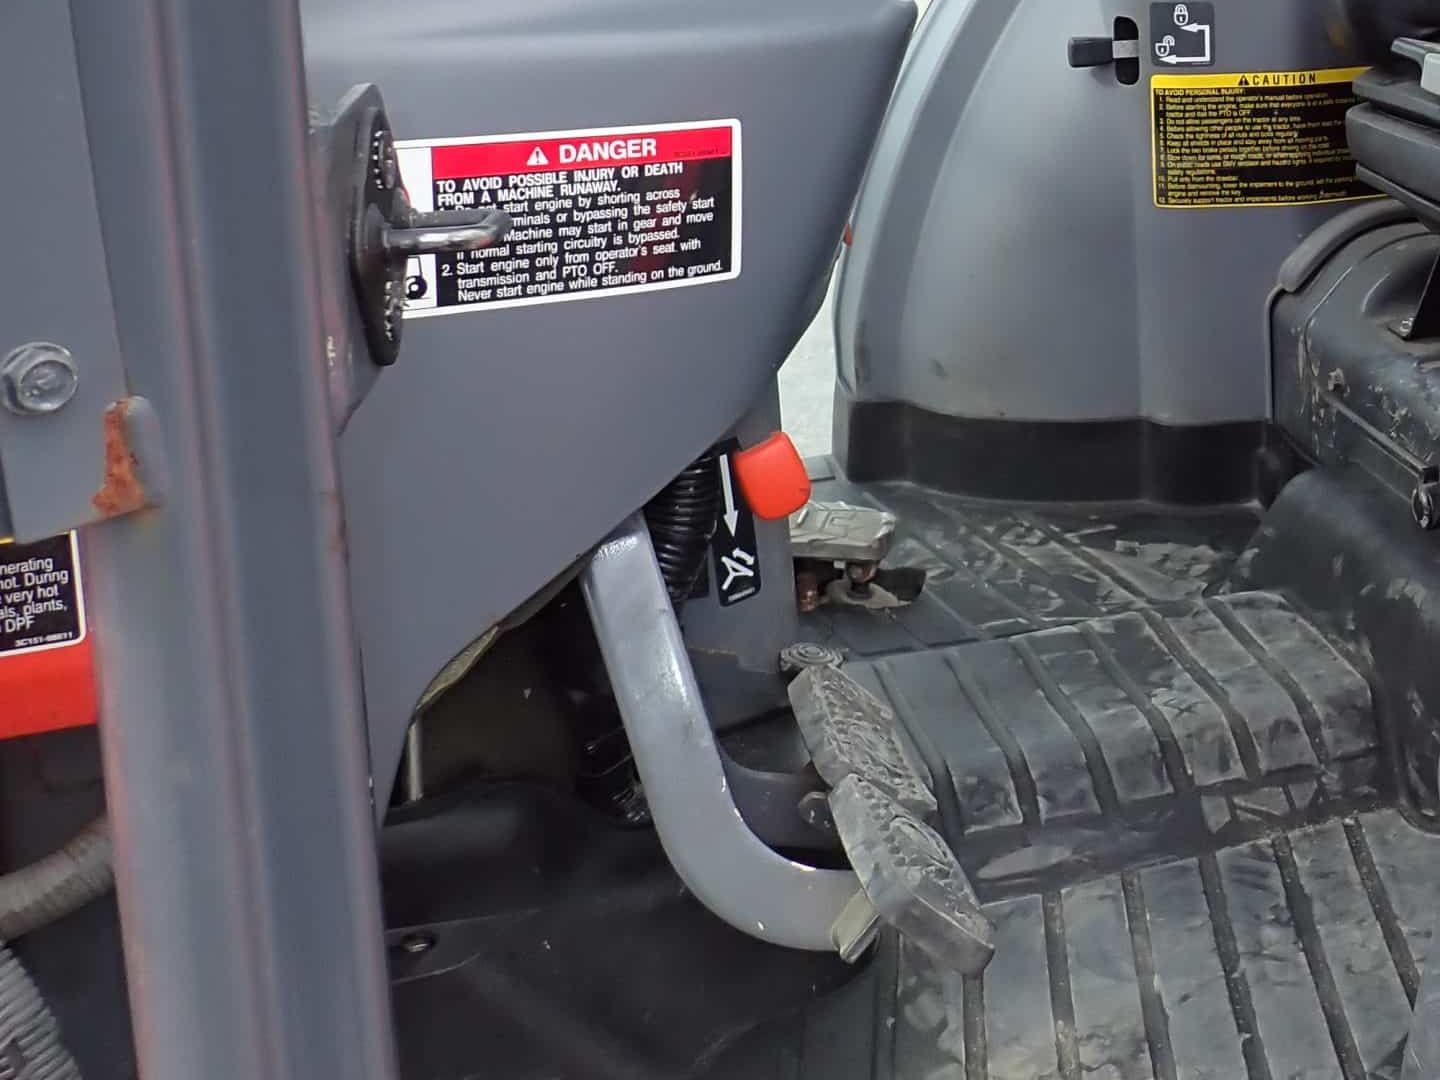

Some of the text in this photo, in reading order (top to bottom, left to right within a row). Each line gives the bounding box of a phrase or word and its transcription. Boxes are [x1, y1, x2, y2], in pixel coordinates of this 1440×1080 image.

[1252, 73, 1316, 86] CAUTION
[559, 138, 657, 164] DANGER
[437, 162, 683, 192] TO AVOID POSSIBLE INJURY OR DEATH
[438, 180, 621, 206] FROM A MACHINE RUNAWAY.
[503, 202, 528, 214] start
[535, 198, 573, 212] engine
[578, 196, 591, 208] by
[597, 191, 640, 206] shorting
[646, 188, 680, 201] across
[556, 212, 568, 222] or
[574, 205, 628, 223] bypassing
[633, 202, 651, 216] the
[656, 200, 687, 215] safety
[692, 196, 715, 210] start
[559, 226, 581, 238] may
[588, 222, 612, 234] start
[618, 220, 628, 232] in
[633, 218, 657, 232] gear
[662, 214, 681, 227] and
[686, 211, 714, 224] move
[471, 244, 510, 260] normal
[516, 241, 558, 256] starting
[564, 235, 607, 250] circuitry
[613, 234, 623, 245] is
[628, 228, 680, 245] bypassed.
[441, 238, 701, 277] 2. Start engine only from operator's seat with
[457, 261, 619, 290] transmission and PTO OFF.
[458, 260, 723, 302] Never start engine while standing on the ground.
[24, 569, 69, 587] During
[5, 584, 59, 604] very hot
[23, 599, 68, 618] plants,
[5, 615, 35, 634] DPF
